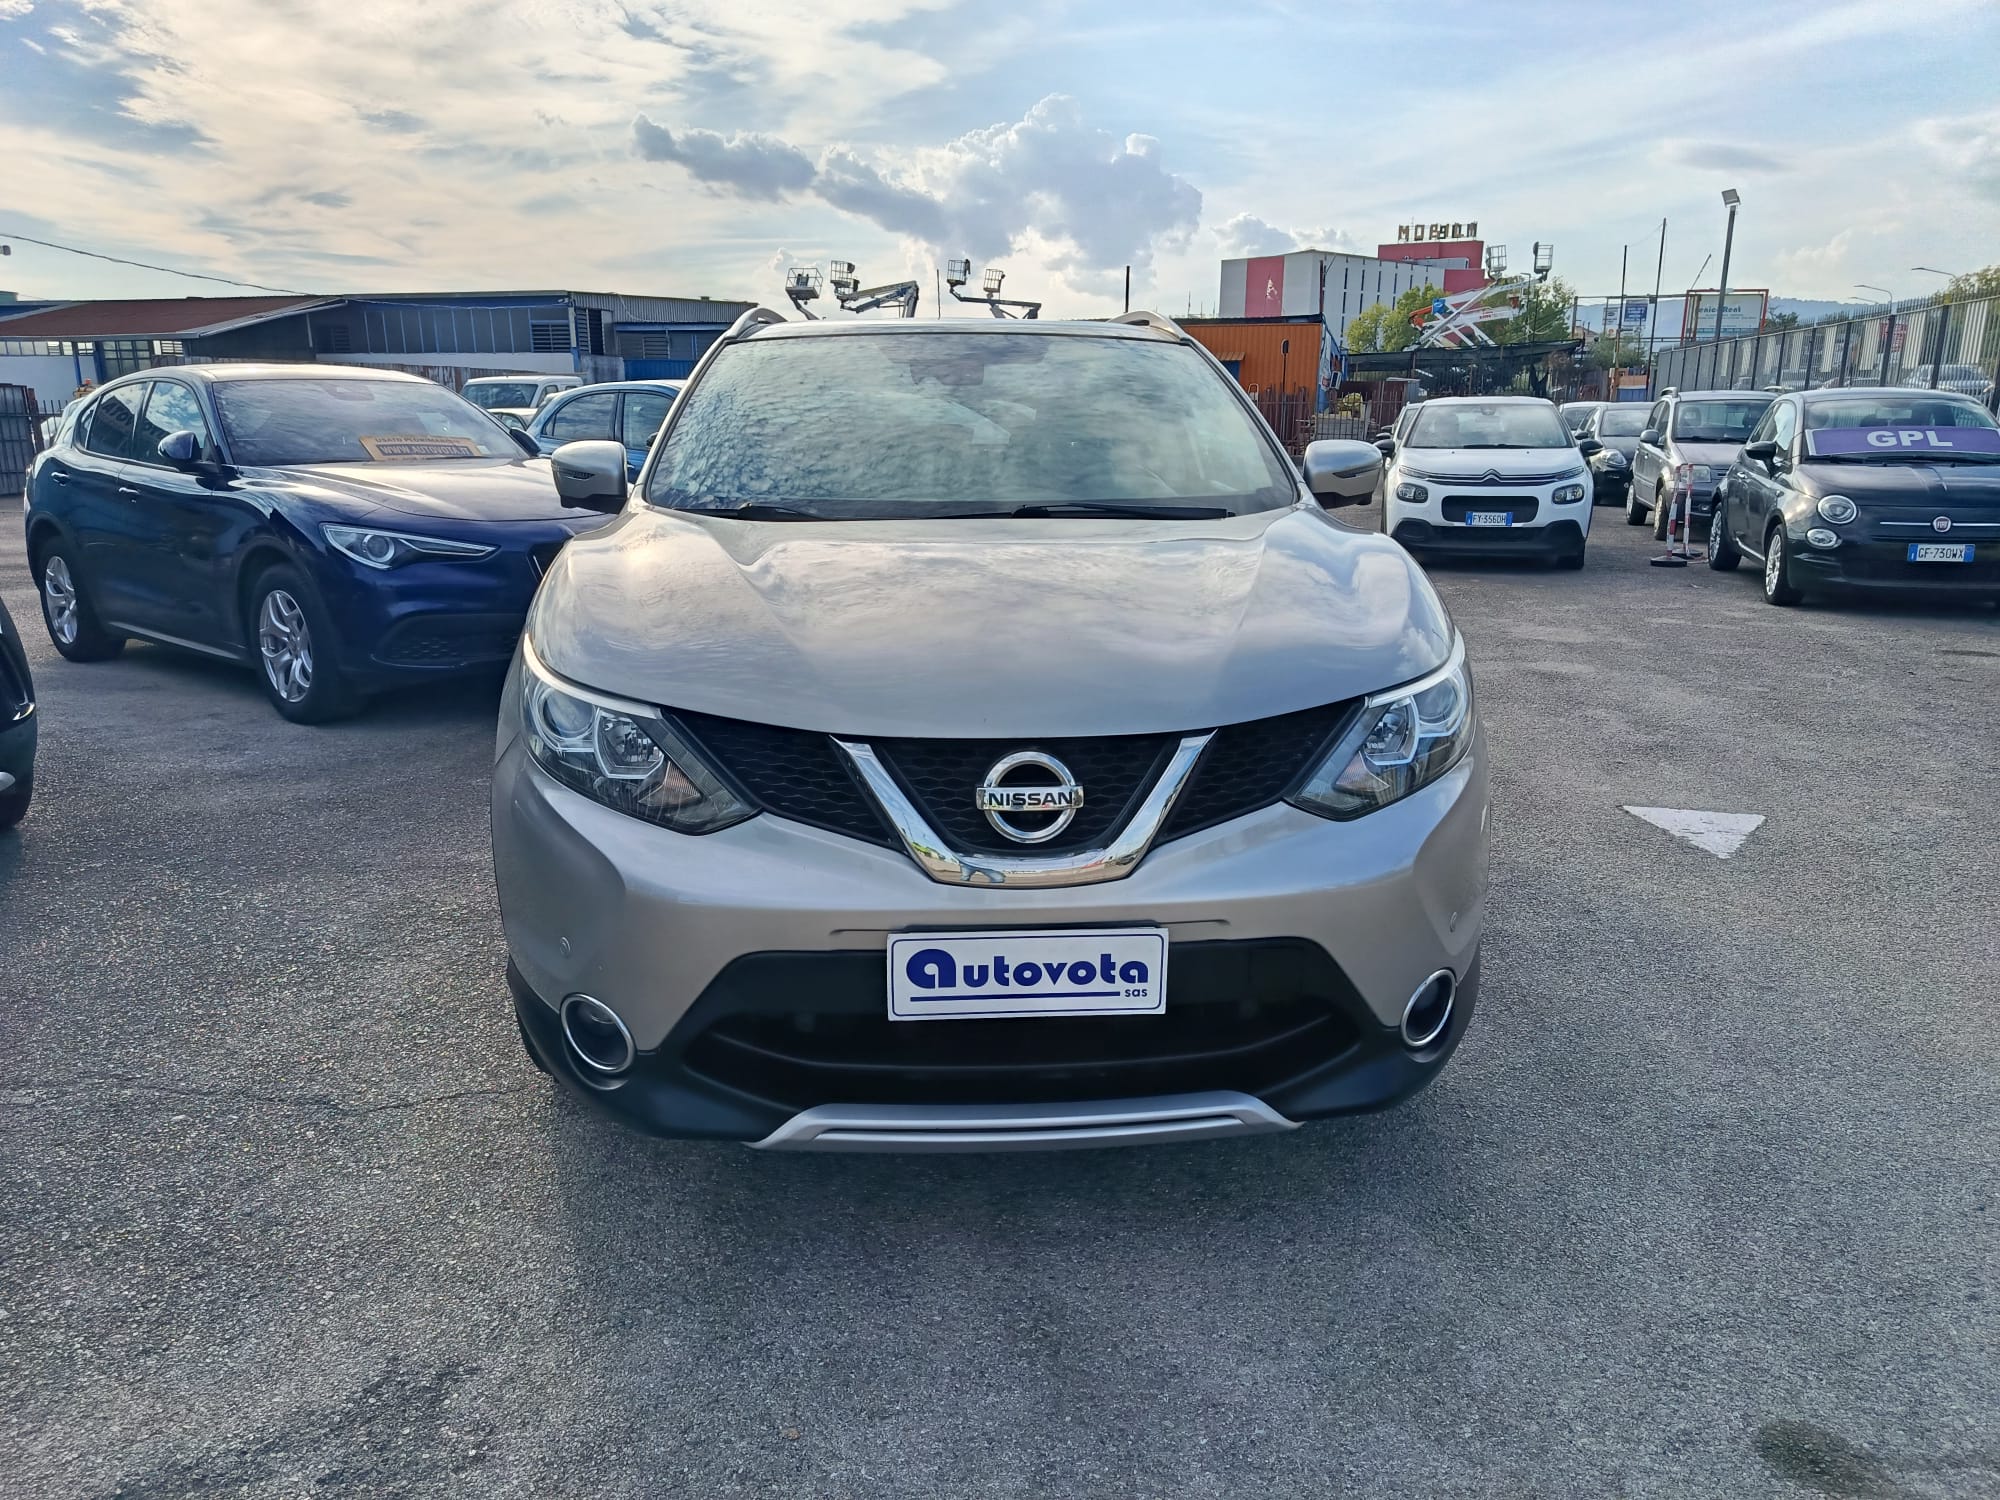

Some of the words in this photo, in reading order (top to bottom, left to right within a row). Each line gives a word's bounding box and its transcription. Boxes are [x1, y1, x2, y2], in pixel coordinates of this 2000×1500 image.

[1867, 430, 1953, 447] GPL
[988, 790, 1074, 807] NISSAN
[1124, 986, 1148, 998] sas
